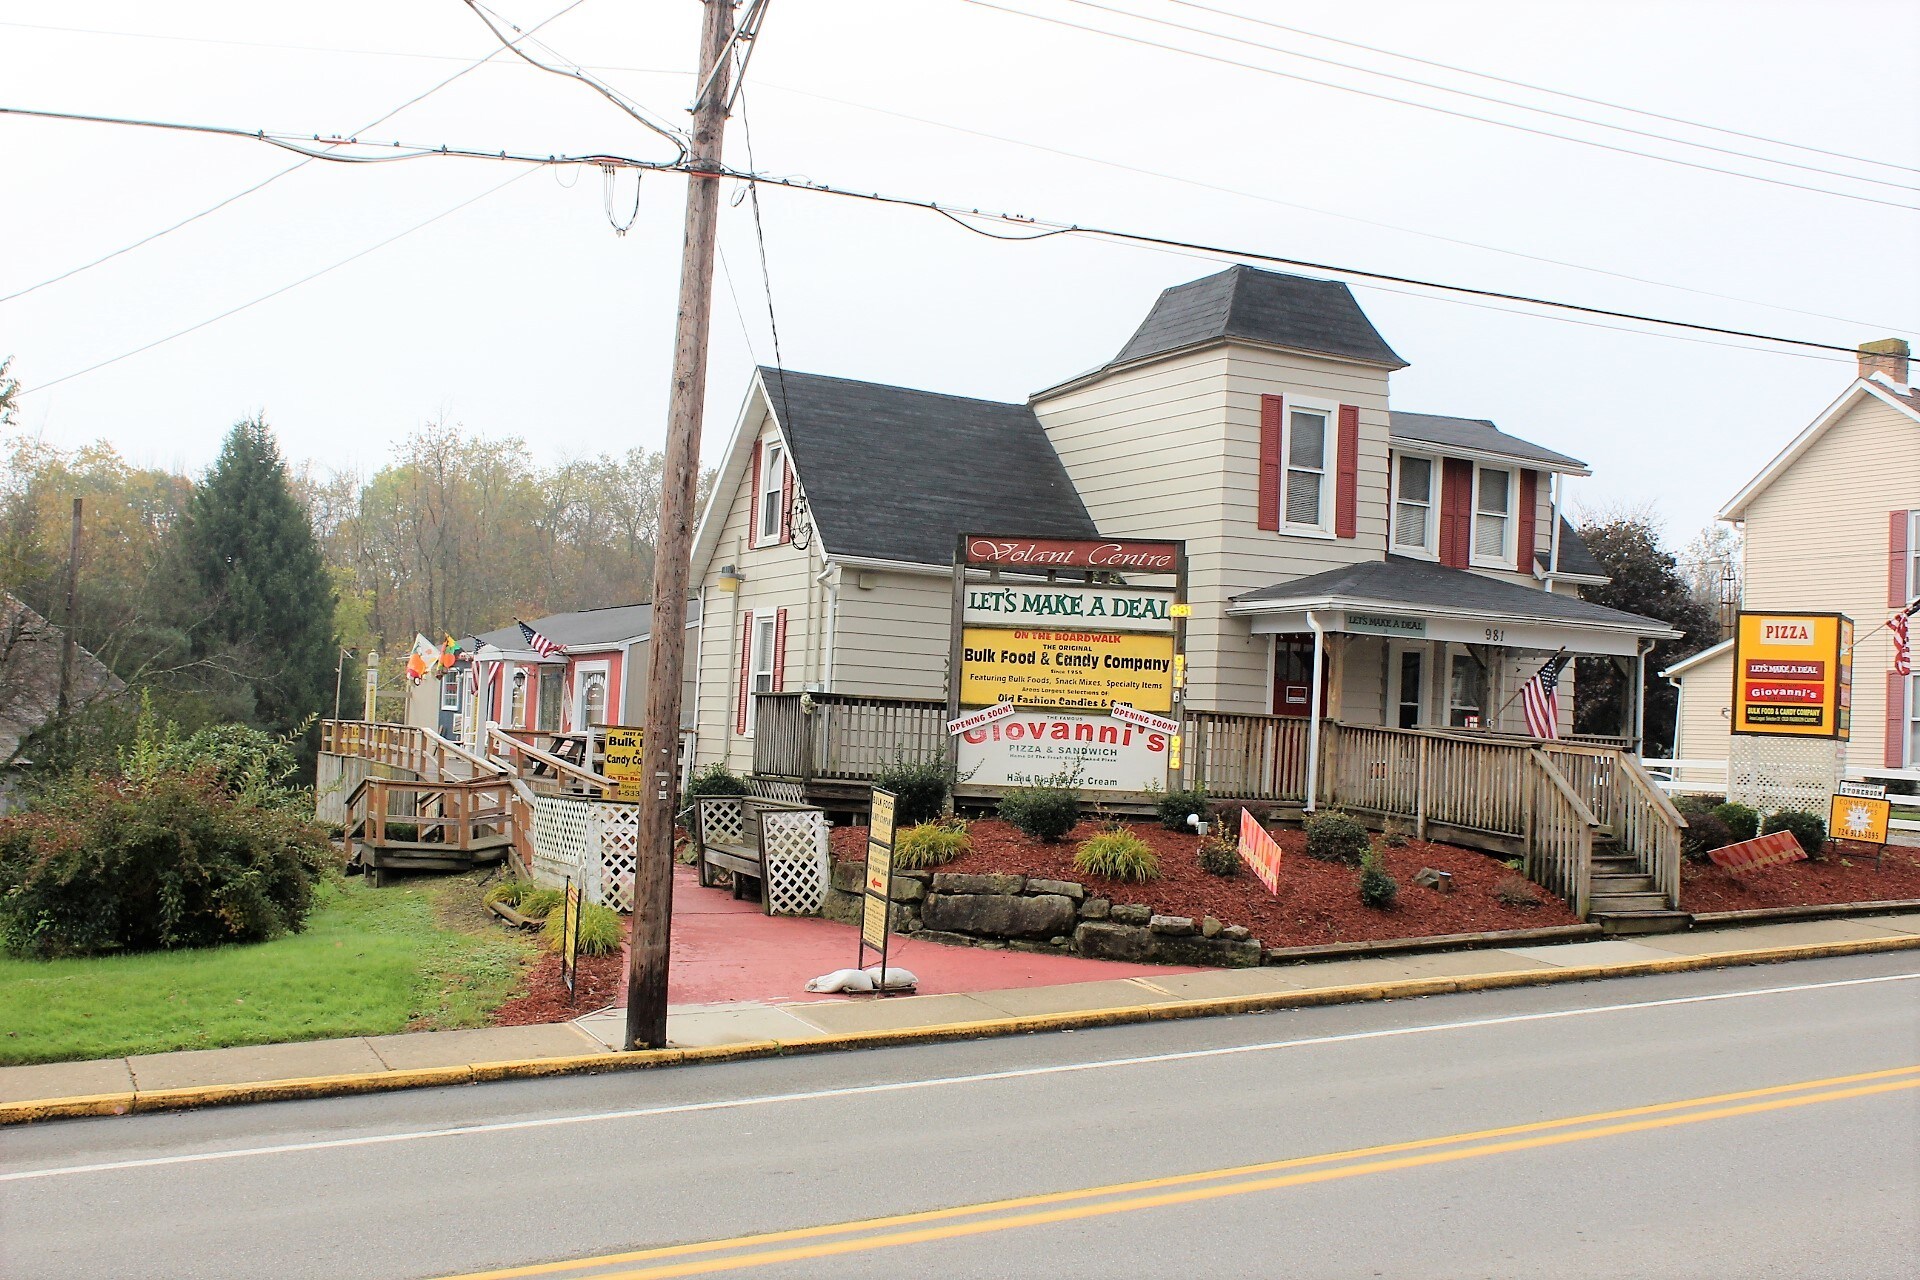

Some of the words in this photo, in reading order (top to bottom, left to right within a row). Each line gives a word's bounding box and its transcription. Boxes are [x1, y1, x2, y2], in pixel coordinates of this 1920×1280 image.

[971, 540, 1075, 563] Volant
[1088, 543, 1171, 567] Centre
[967, 588, 1017, 614] LET'S
[1020, 593, 1084, 617] MAKE
[1086, 596, 1107, 616] A
[1111, 597, 1172, 621] DEAL
[1170, 605, 1191, 617] 981
[1349, 616, 1368, 625] LET'S
[1369, 617, 1392, 628] MAKE
[1391, 618, 1401, 628] A
[1401, 619, 1423, 631] DEAL
[1014, 630, 1029, 640] ON
[1031, 631, 1052, 640] THE
[1054, 632, 1122, 644] BOARDWALK
[1485, 628, 1504, 642] 981
[1766, 625, 1809, 639] PIZZA
[1058, 644, 1093, 652] ORIGINAL
[964, 647, 996, 663] Bulk
[1000, 649, 1036, 665] Food
[1040, 651, 1051, 666] &
[1055, 652, 1100, 670] Candy
[1104, 654, 1170, 673] Company
[1789, 665, 1798, 674] A
[1797, 665, 1818, 674] DEAL
[970, 673, 1007, 683] Featuring
[1008, 675, 1025, 683] Bulk
[1027, 676, 1052, 685] Foods,
[1055, 677, 1077, 686] Snack
[1106, 679, 1140, 690] Specialty
[1142, 681, 1163, 690] Items
[1751, 687, 1817, 699] Giovanni's
[997, 693, 1015, 703] Old
[1017, 695, 1056, 705] Fashion
[1058, 697, 1098, 707] Candies
[1100, 698, 1108, 708] &
[950, 714, 986, 733] OPENING
[987, 704, 1013, 719] SOON!
[1747, 707, 1761, 715] BULK
[1761, 707, 1775, 715] FOOD
[1780, 708, 1796, 716] CANDY
[1796, 709, 1821, 717] COMPANY
[1113, 707, 1150, 724] OPENING
[1151, 718, 1177, 733] SOON!
[962, 718, 1165, 752] Giovanni's
[608, 737, 636, 748] Bulk
[1009, 744, 1042, 753] PIZZA
[1046, 746, 1054, 754] &
[1058, 746, 1118, 757] SANDWICH
[606, 754, 631, 768] Candy
[1007, 773, 1032, 783] Hand
[1087, 777, 1118, 787] Cream
[1841, 787, 1883, 797] STOREROOM
